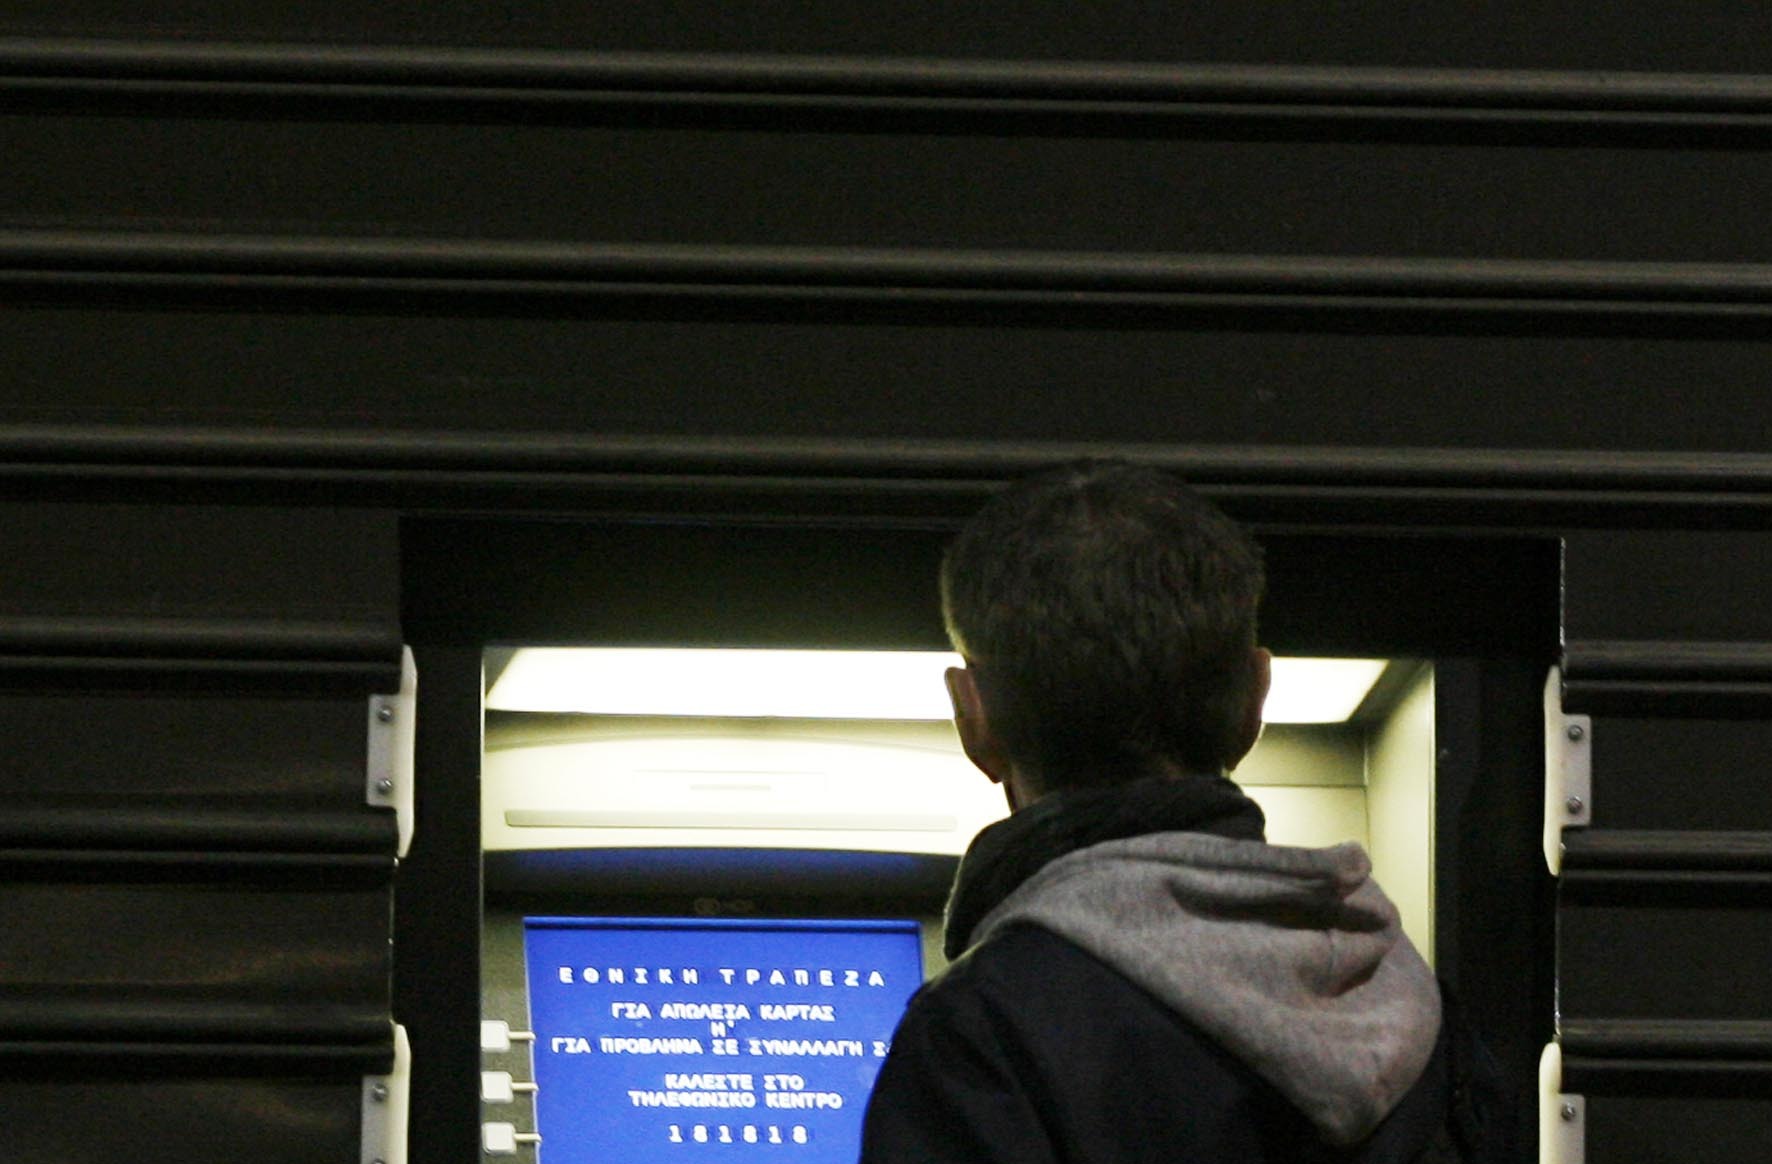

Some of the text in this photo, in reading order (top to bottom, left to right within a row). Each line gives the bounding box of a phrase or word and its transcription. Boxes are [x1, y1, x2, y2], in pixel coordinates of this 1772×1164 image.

[558, 966, 885, 987] ΕΘΝΙΚΗ ΤΡΑΠΕΖΑ
[611, 1002, 836, 1022] ΓΙΑ ΑΠΩΛΕΙΑ ΚΑΡΤΑΣ
[551, 1037, 592, 1054] ΓΙΑ
[599, 1037, 704, 1055] ΠΡΟΒΛΗΜΑ
[711, 1038, 740, 1056] ΣΕ
[745, 1037, 864, 1057] ΣΥΝΑΛΛΑΓΗ
[663, 1073, 805, 1091] ΚΑΛΕΣΤΕ ΣΤΟ
[627, 1089, 844, 1110] ΤΗΛΕΦΩΝΙΚΟ ΚΕΝΤΡΟ
